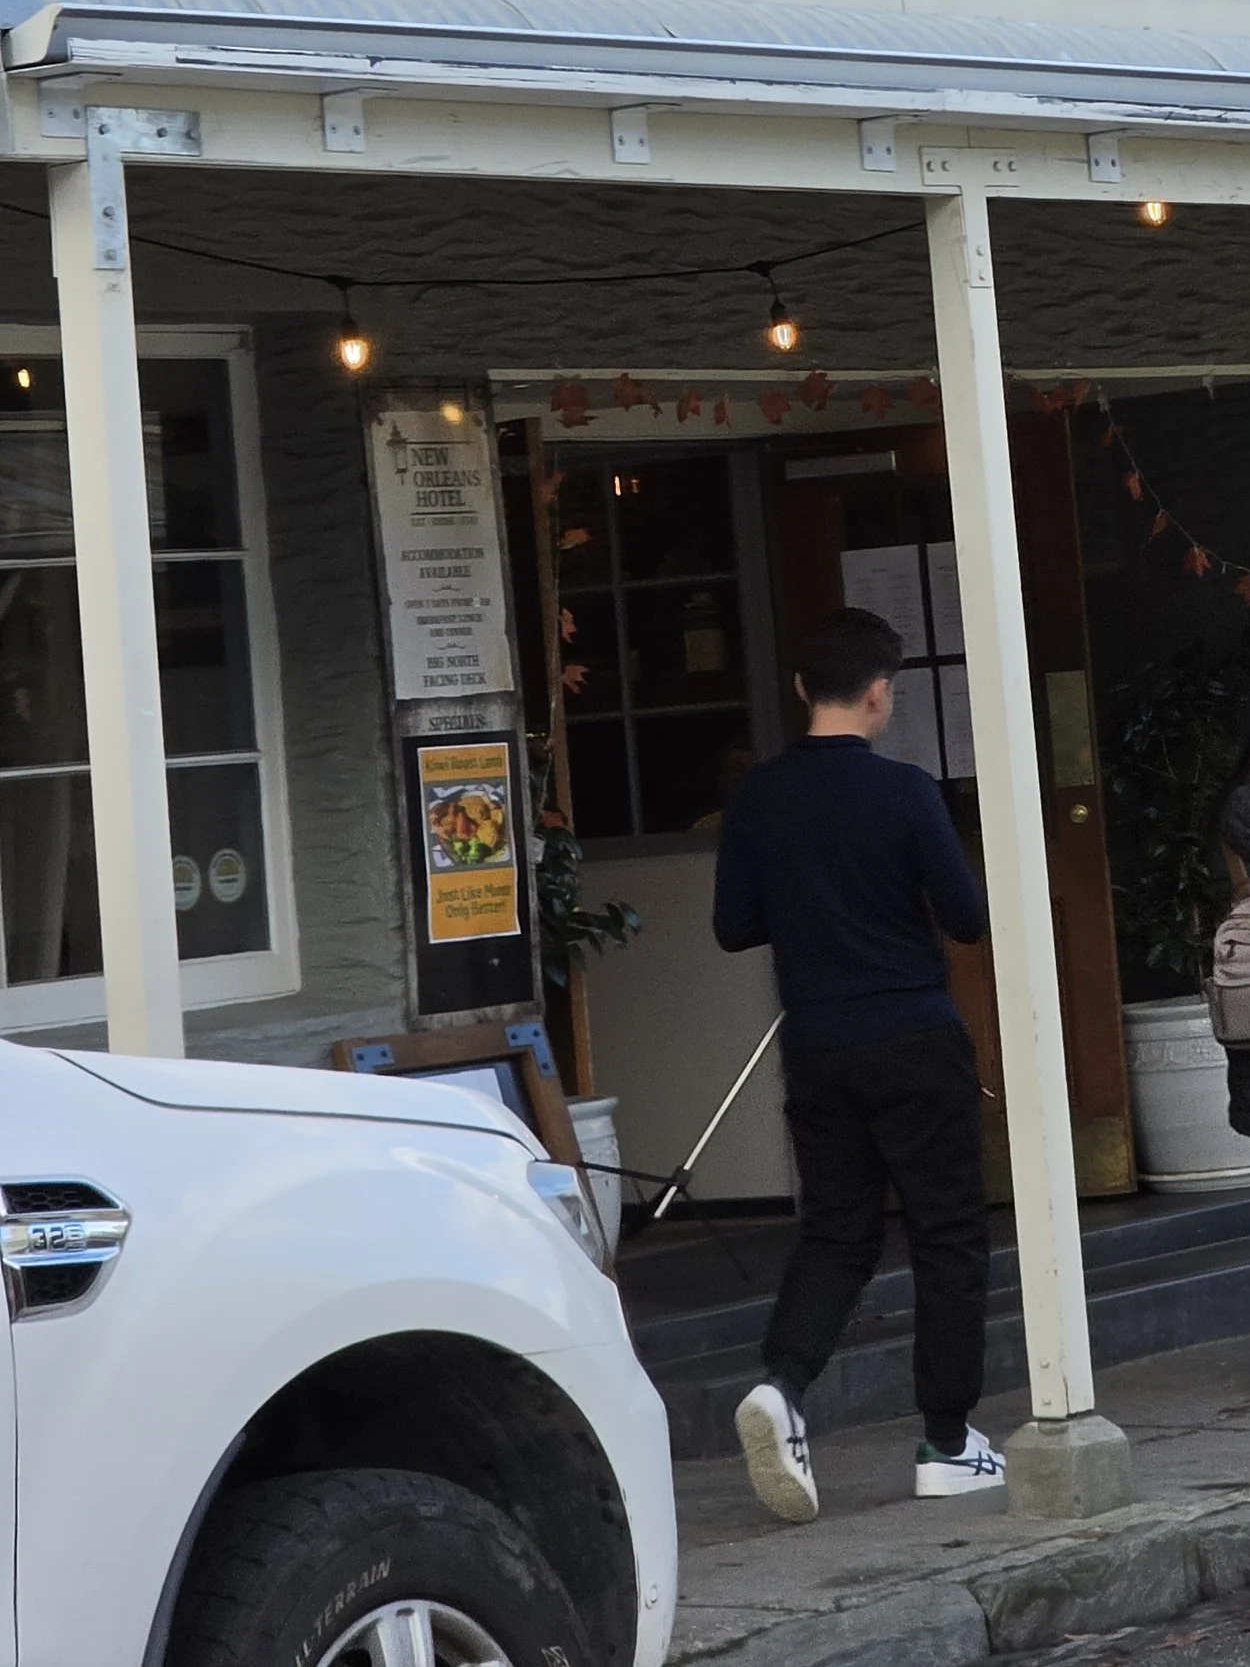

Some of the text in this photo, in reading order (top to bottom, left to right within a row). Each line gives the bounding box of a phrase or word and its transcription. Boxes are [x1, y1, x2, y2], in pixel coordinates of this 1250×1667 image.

[410, 447, 448, 466] NEW
[413, 469, 480, 487] ORLEANS
[416, 490, 465, 507] HOTEL
[312, 1557, 392, 1636] TERRAIN
